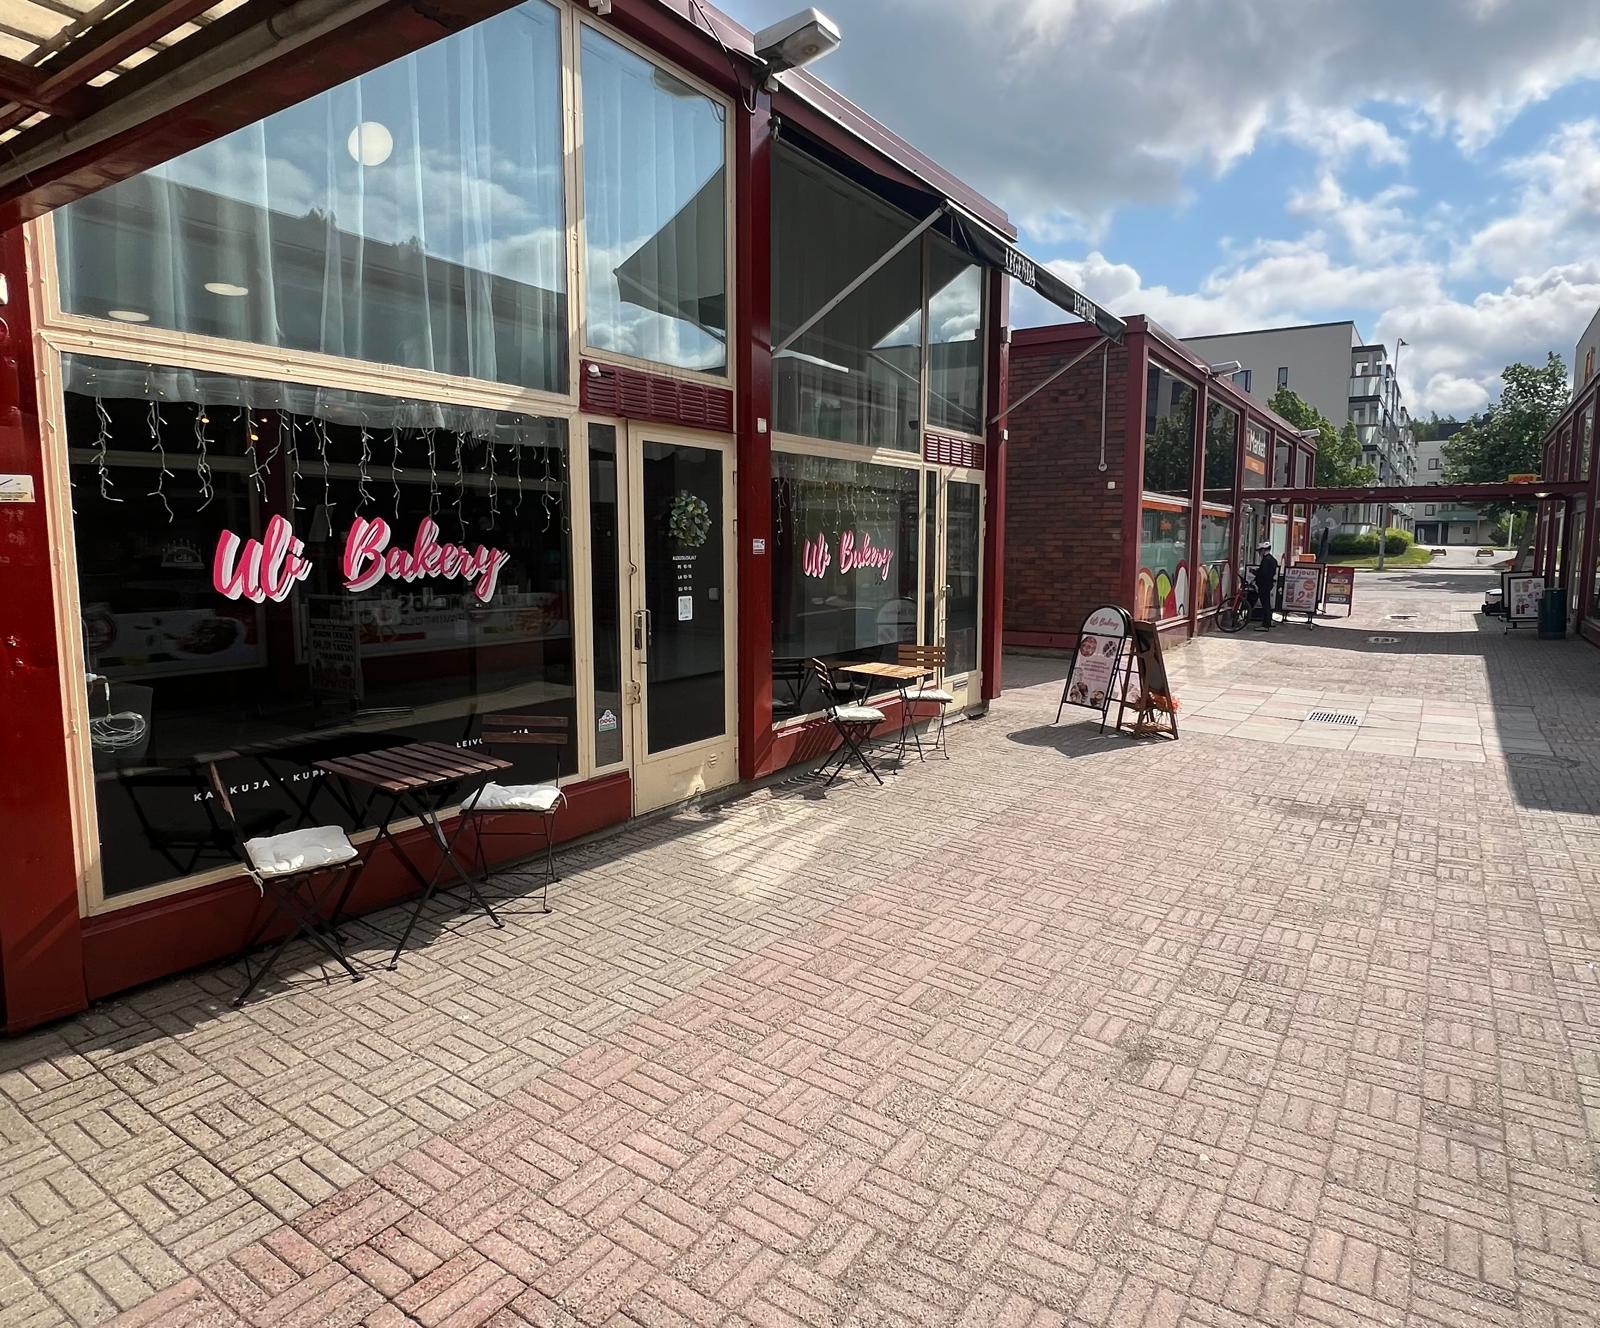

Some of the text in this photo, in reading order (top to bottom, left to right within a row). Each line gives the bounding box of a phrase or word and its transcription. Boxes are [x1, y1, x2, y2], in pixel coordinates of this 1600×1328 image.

[1005, 248, 1035, 286] LEGENDA
[1074, 293, 1095, 324] LEGENDA
[213, 514, 511, 603] Uli Bakery
[839, 530, 893, 580] Bakery
[193, 779, 270, 802] KAKUJA
